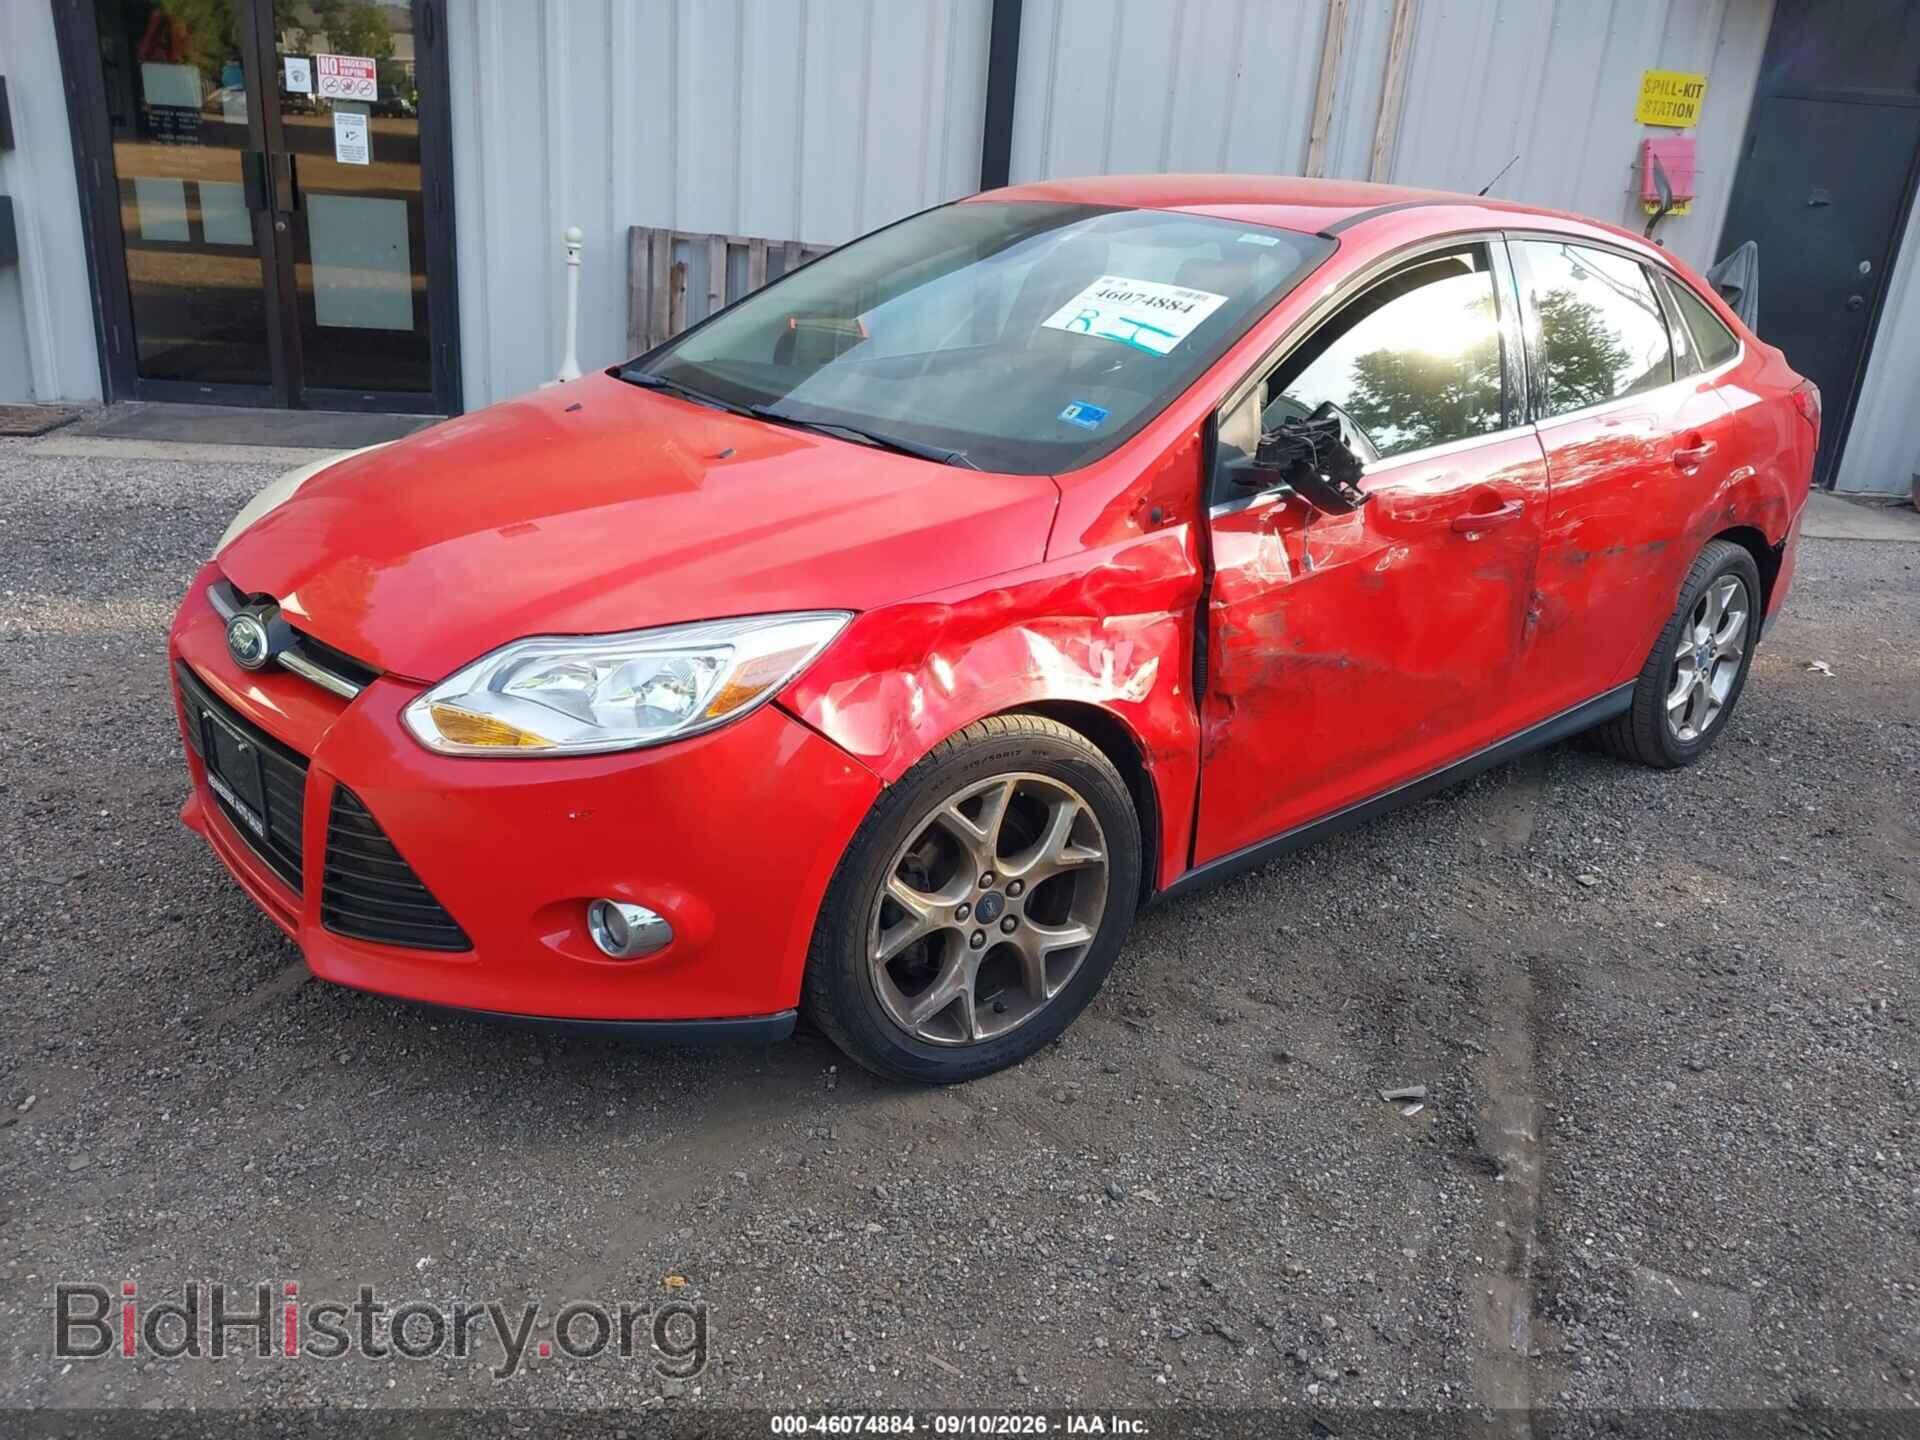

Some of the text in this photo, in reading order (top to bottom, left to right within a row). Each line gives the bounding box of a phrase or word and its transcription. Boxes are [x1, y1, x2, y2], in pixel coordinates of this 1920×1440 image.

[320, 57, 338, 75] NO
[339, 58, 373, 69] SMOKING
[339, 68, 368, 78] VAPING
[1644, 79, 1704, 99] SPILL-KIT
[1643, 100, 1695, 119] STATION
[1095, 288, 1195, 315] 46074884
